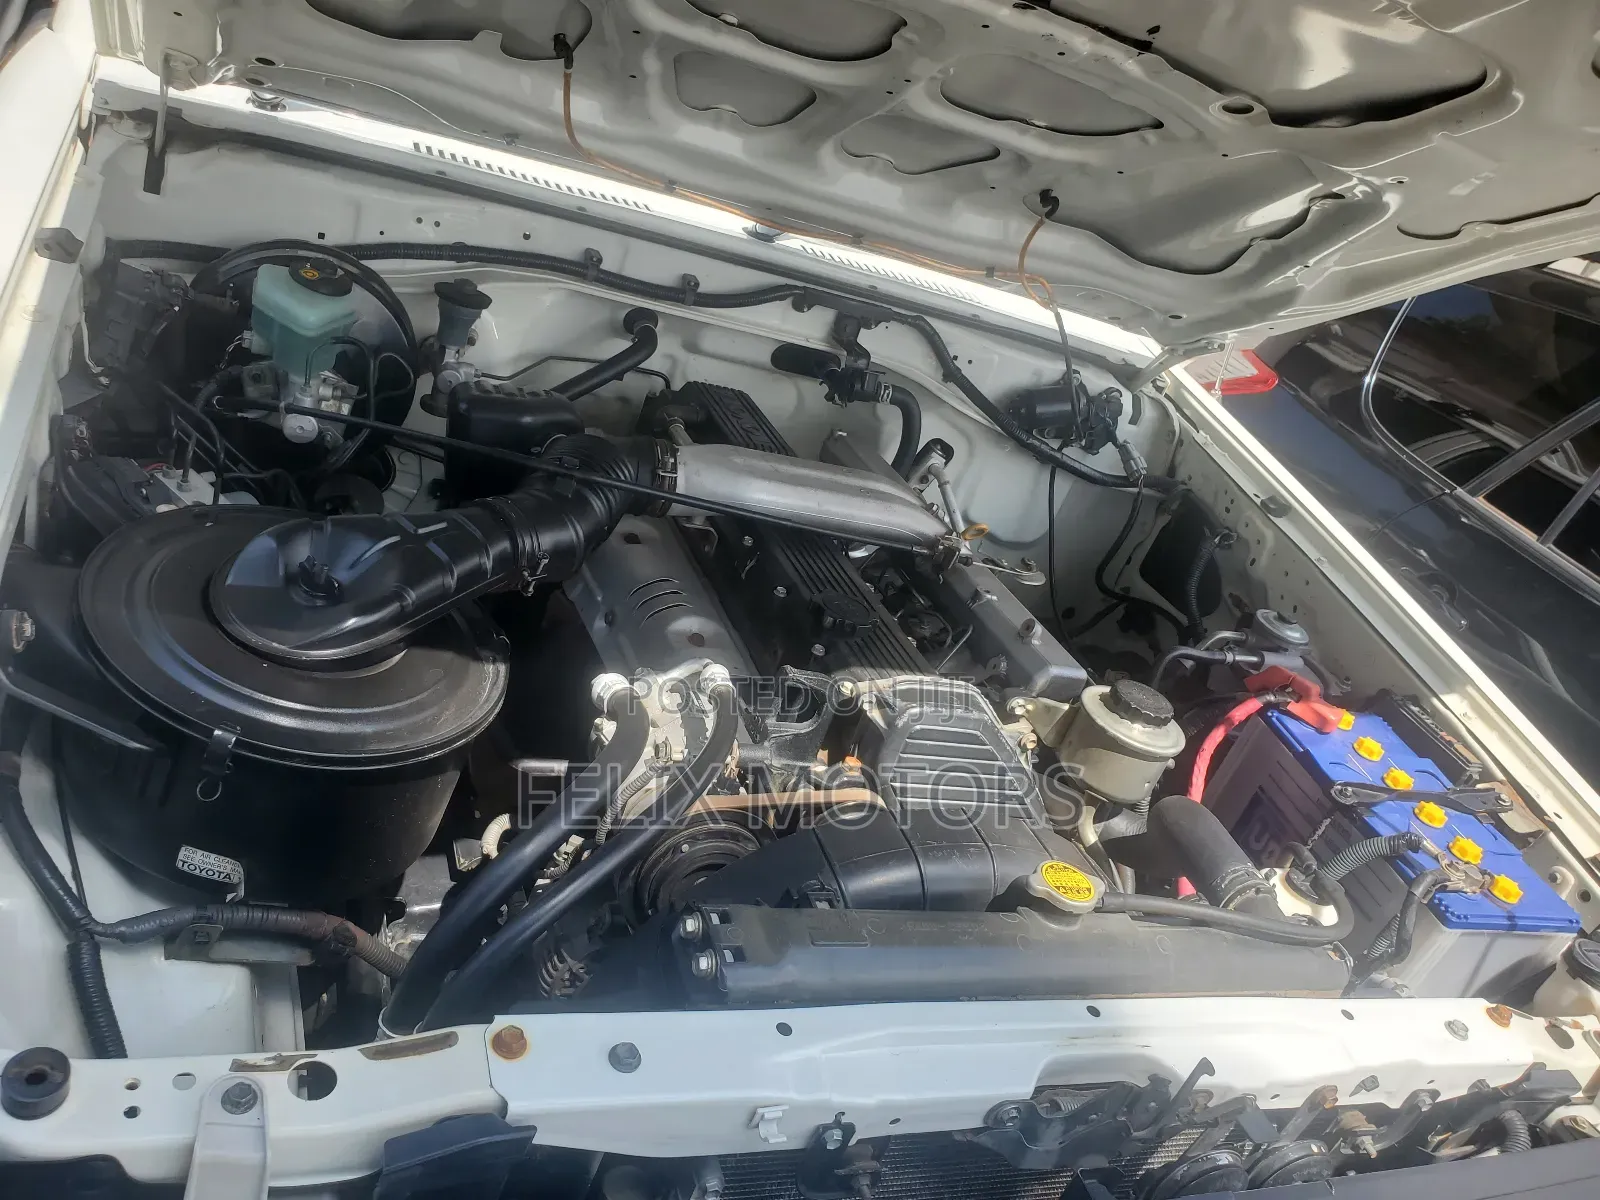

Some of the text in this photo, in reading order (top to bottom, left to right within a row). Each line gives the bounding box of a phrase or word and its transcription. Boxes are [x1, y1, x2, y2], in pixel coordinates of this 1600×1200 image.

[182, 853, 196, 861] SEE
[184, 847, 198, 856] FOR
[200, 852, 211, 860] AIR
[179, 859, 232, 881] TOYOTA
